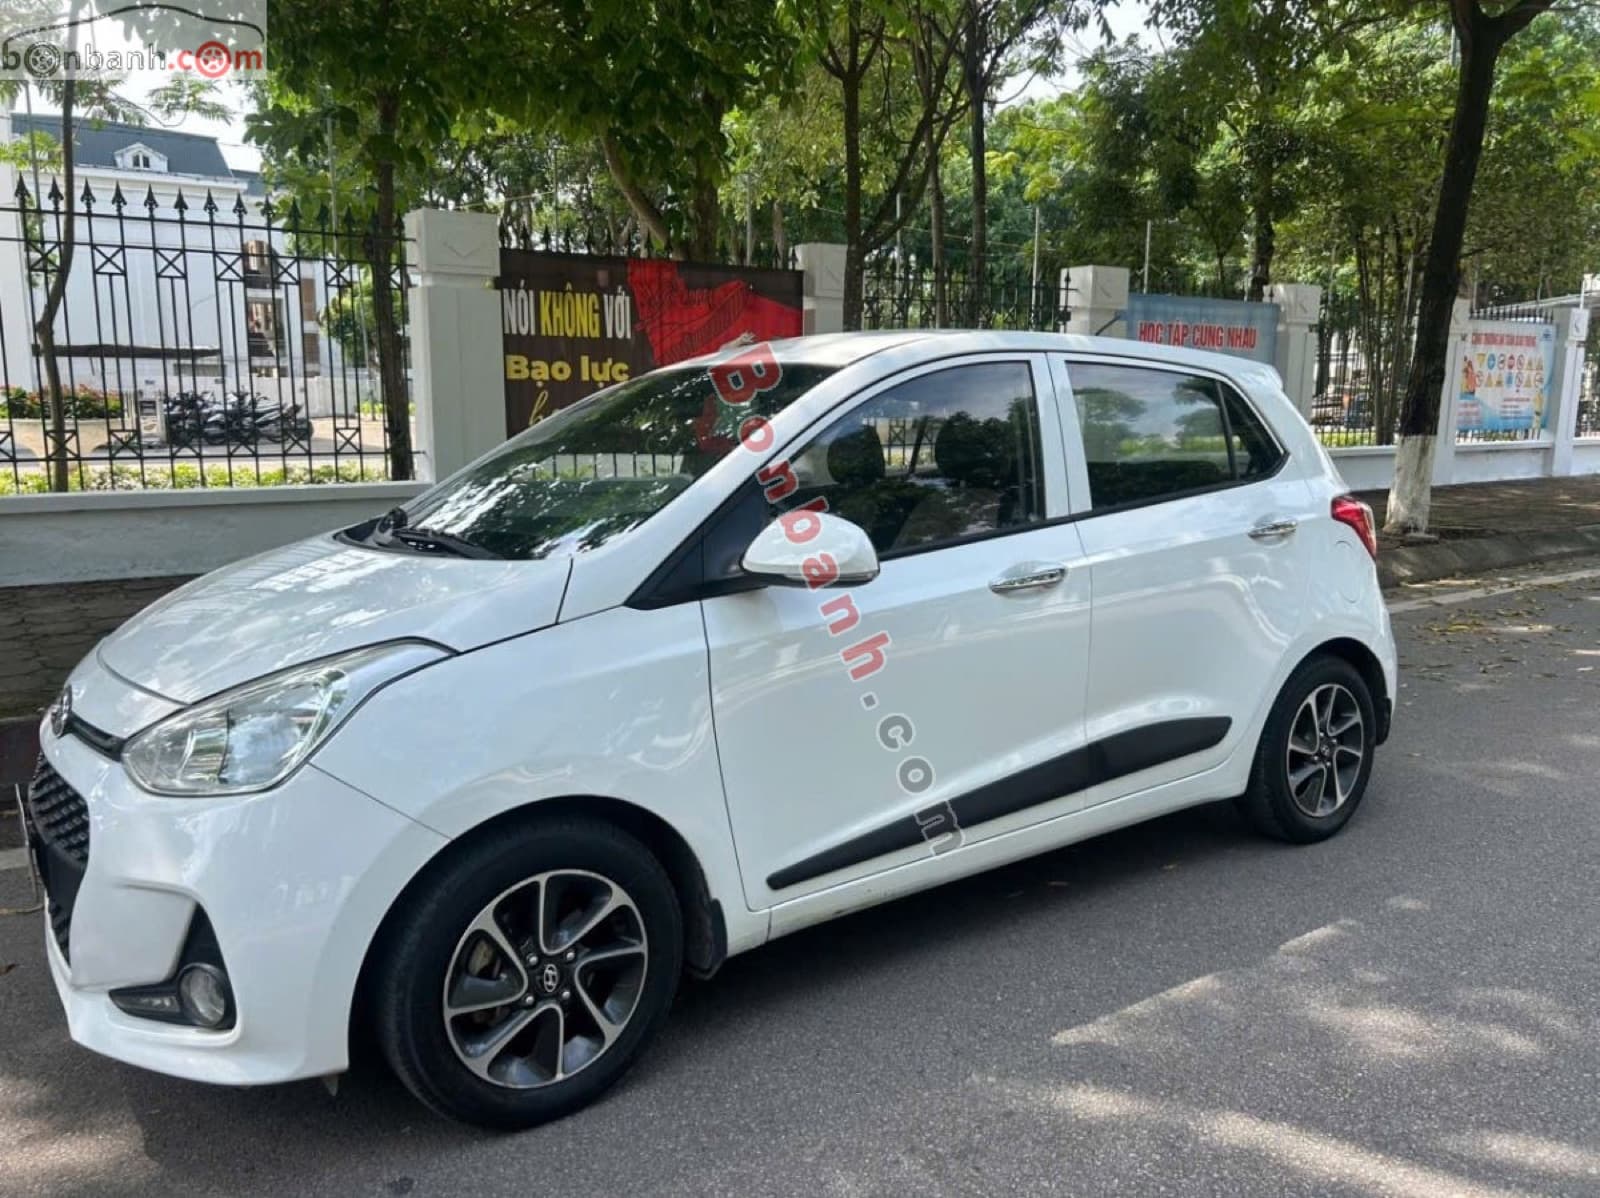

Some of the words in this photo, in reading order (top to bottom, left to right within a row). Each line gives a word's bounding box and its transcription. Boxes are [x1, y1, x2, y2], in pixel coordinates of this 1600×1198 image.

[503, 279, 535, 336] NÓI
[539, 282, 600, 338] KHÔNG
[604, 285, 632, 339] VỚI
[1227, 326, 1257, 349] NHAU
[506, 355, 571, 388] Bạo
[581, 355, 630, 388] lực
